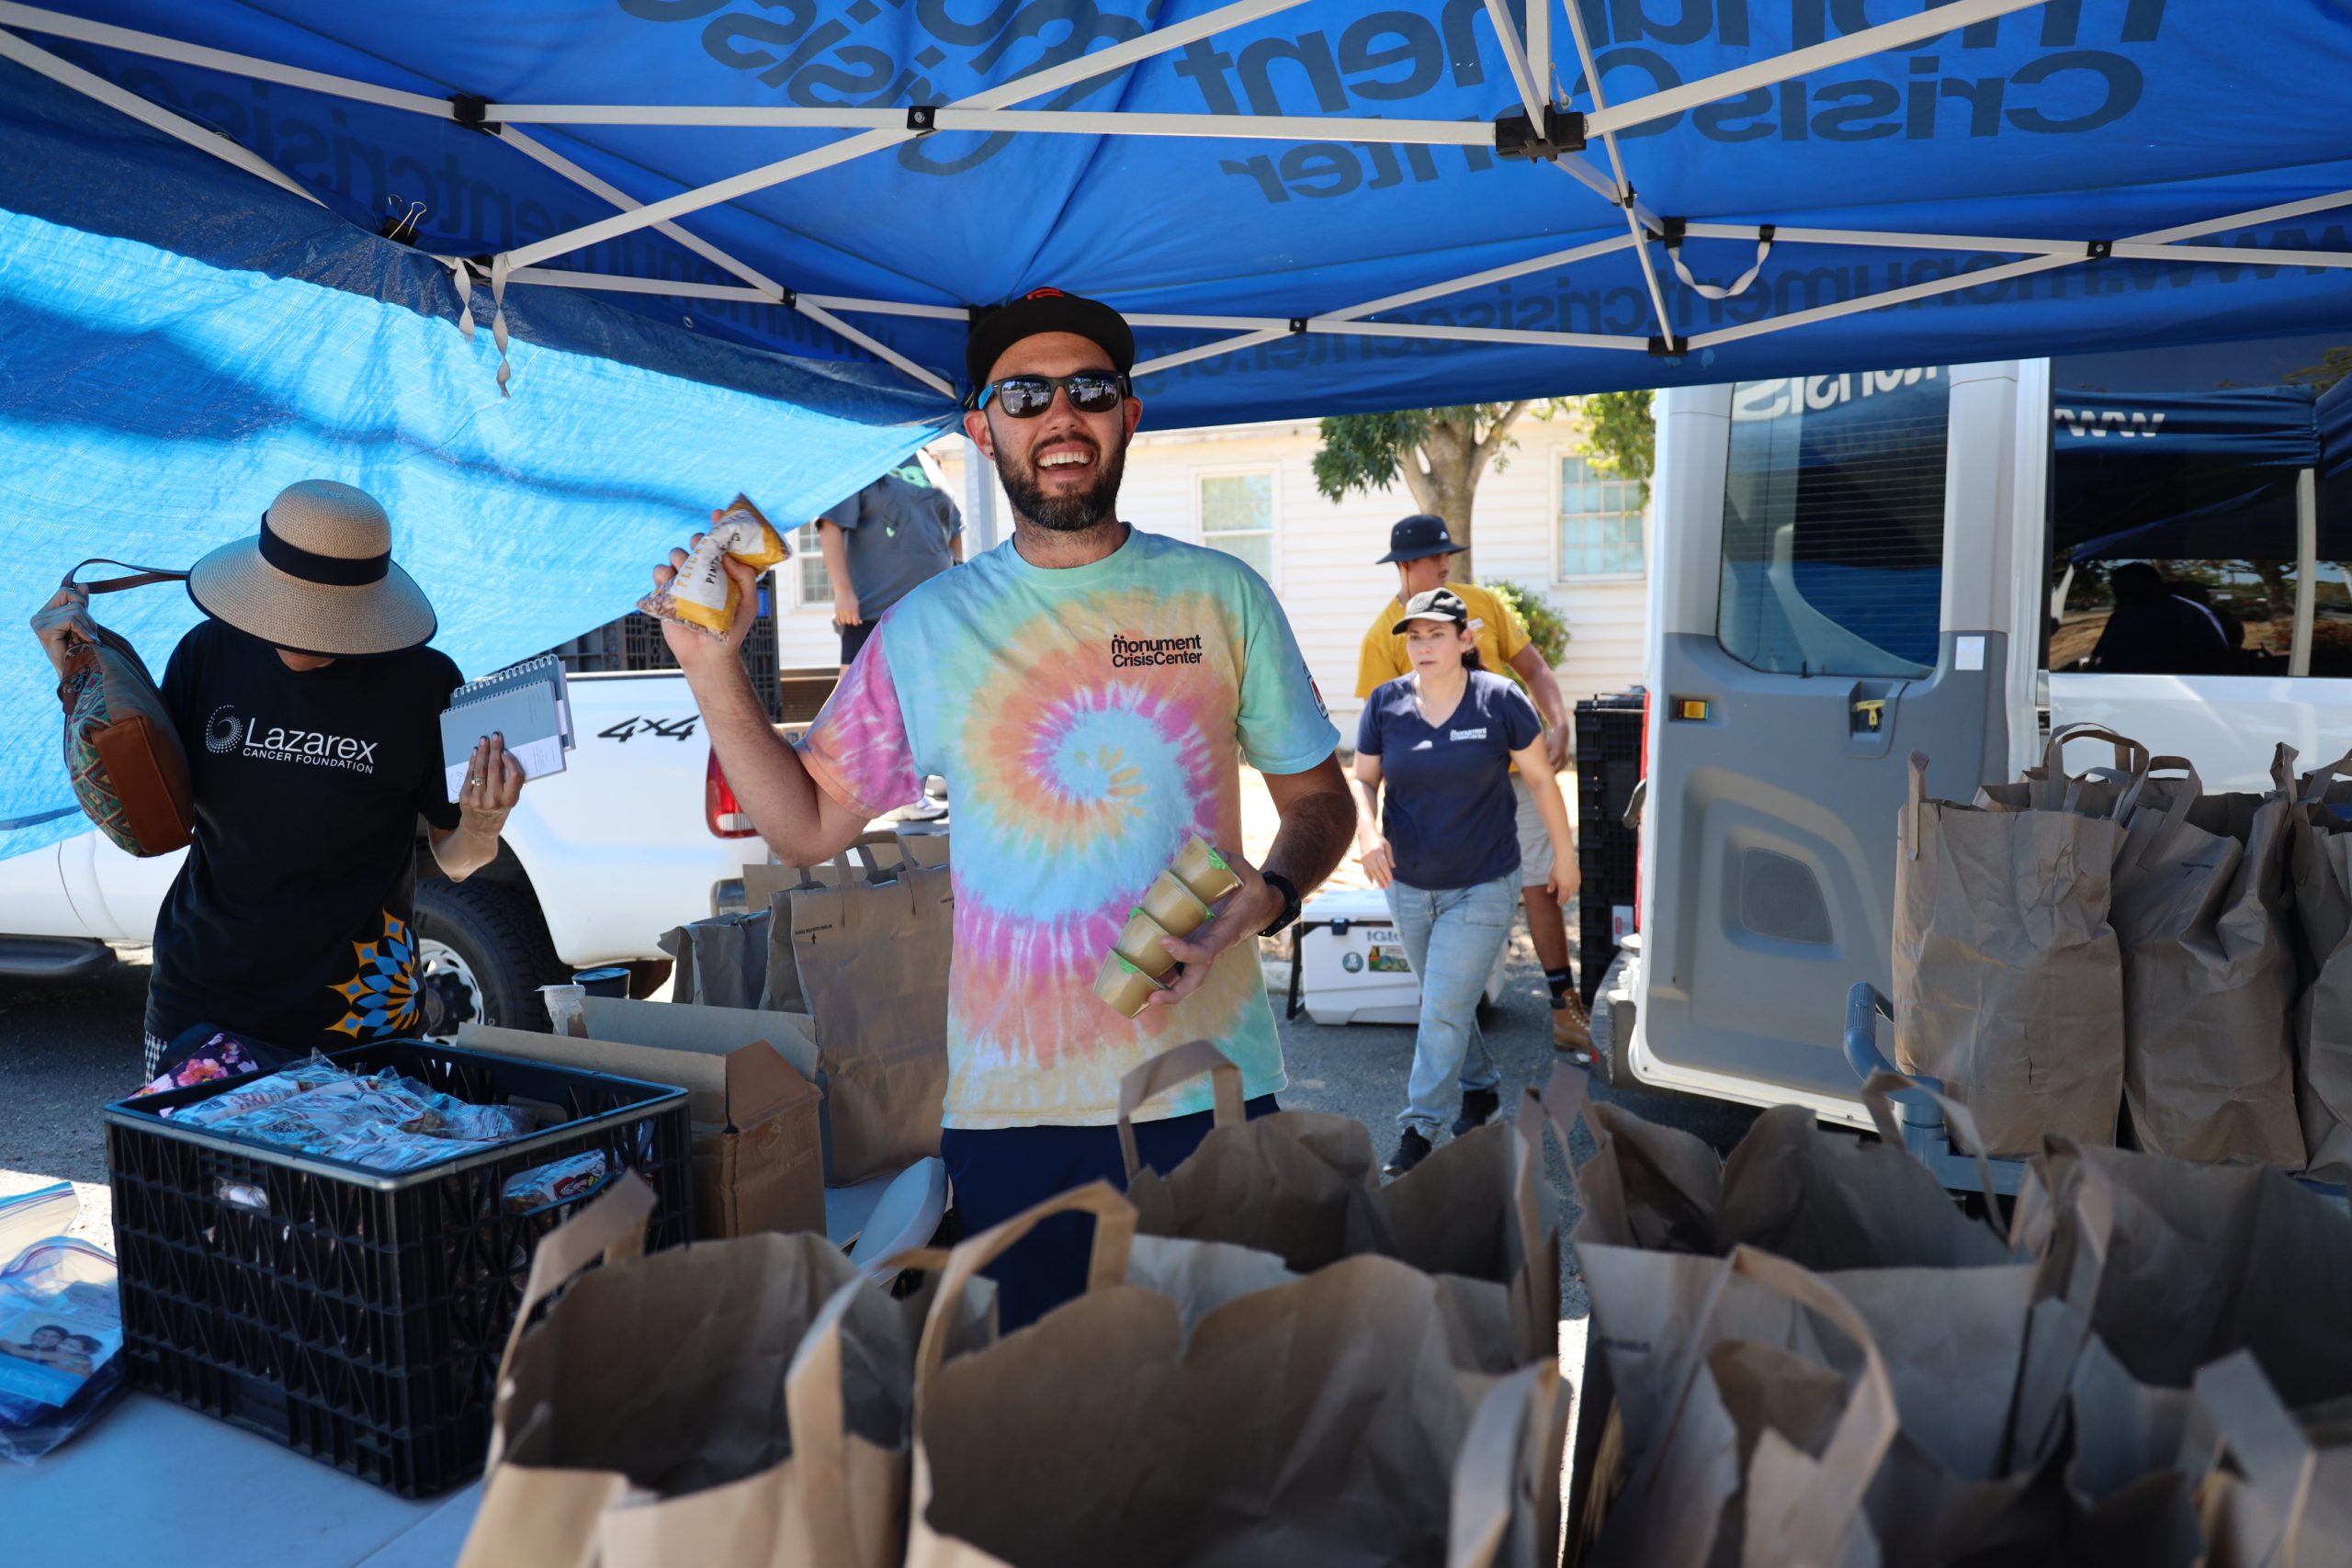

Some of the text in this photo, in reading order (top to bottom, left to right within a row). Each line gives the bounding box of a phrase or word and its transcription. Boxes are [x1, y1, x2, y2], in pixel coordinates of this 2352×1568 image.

[1111, 634, 1202, 654] monument
[1112, 650, 1203, 668] CrisisCenter
[244, 717, 379, 764] Lazarex
[243, 747, 374, 774] CANCER FOUNDATION
